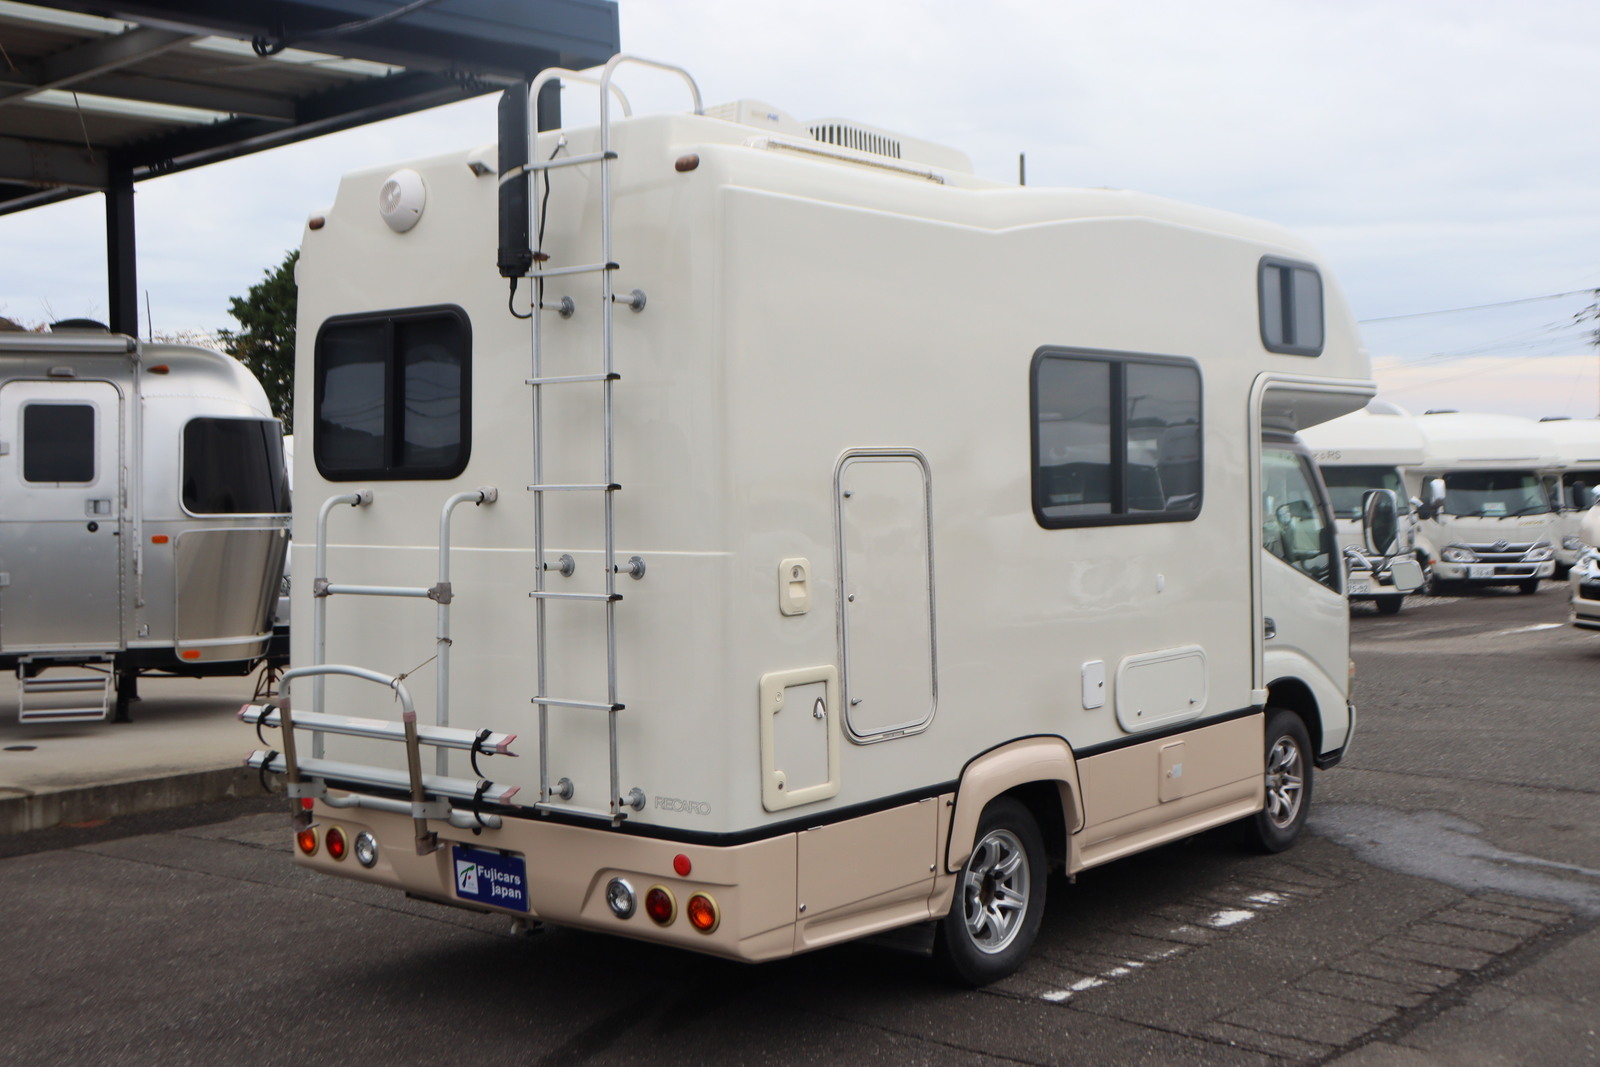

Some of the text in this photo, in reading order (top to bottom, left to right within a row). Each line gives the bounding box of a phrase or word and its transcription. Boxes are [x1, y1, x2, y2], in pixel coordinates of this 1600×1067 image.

[655, 796, 711, 815] RECARO
[477, 865, 521, 885] Fujicars
[491, 881, 522, 900] japan
